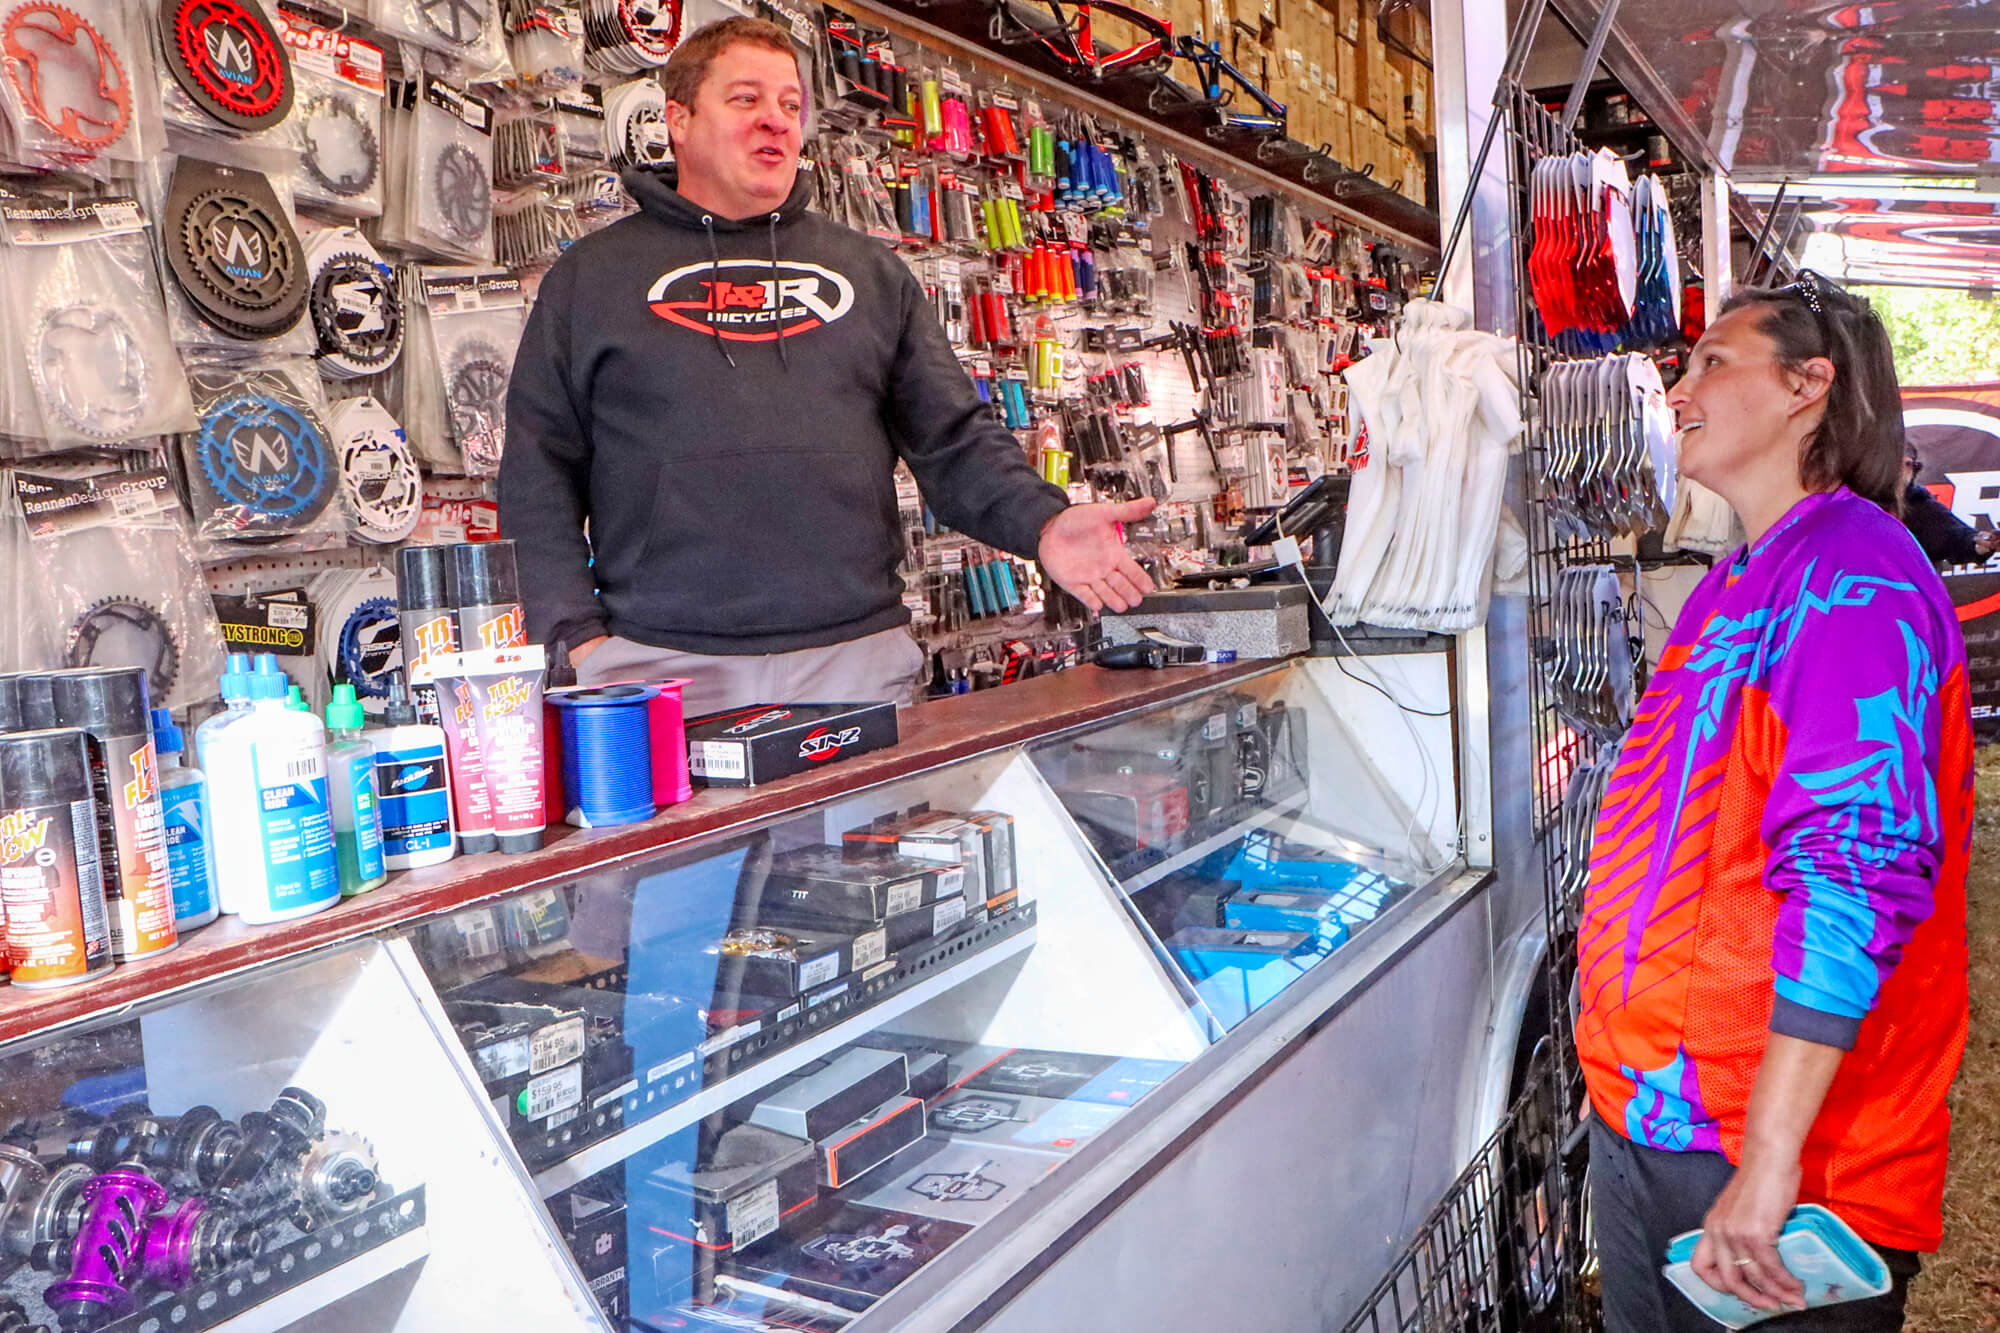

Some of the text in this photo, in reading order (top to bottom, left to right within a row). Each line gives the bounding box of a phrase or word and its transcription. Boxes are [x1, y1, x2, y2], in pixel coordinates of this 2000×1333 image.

[279, 17, 350, 58] Profile
[218, 69, 253, 84] AVIAN
[225, 265, 262, 279] AVIAN
[706, 307, 808, 324] BICYCLES
[251, 472, 291, 485] AVIAN
[24, 475, 168, 515] RennenDesignGroup
[421, 502, 472, 524] rofile
[220, 624, 287, 645] AYSTRONG
[487, 675, 523, 702] TRI-
[484, 684, 531, 722] FLOW
[798, 726, 861, 758] SINZ
[263, 786, 296, 800] CLEAN
[166, 825, 186, 837] LEAN
[167, 836, 181, 846] IDE
[590, 1268, 625, 1290] ARRANTY
